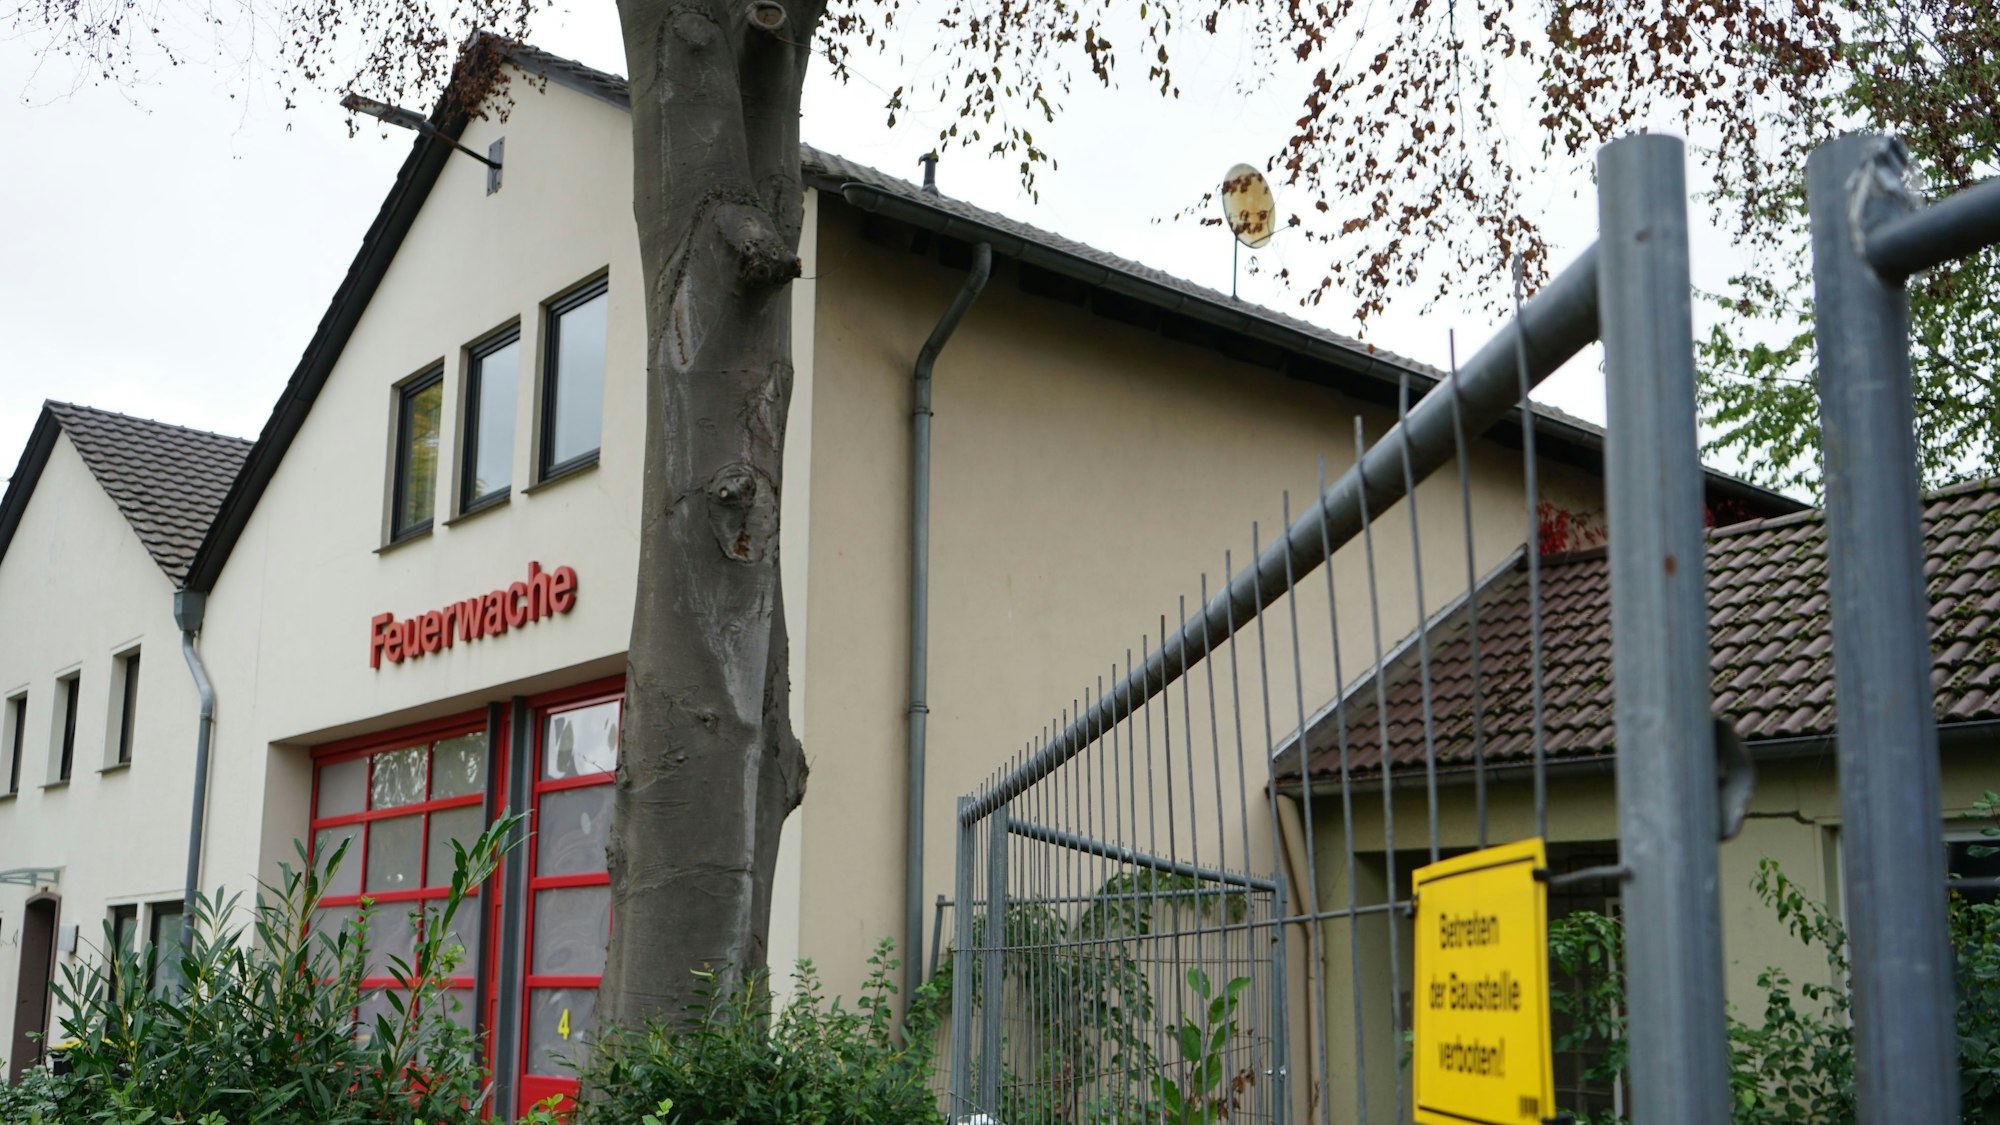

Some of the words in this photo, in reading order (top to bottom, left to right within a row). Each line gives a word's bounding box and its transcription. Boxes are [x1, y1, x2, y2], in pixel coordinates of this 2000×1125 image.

[370, 560, 577, 669] Feuerwache
[1440, 911, 1499, 949] Betreten
[1430, 973, 1446, 1010] der
[1450, 971, 1522, 1012] Baustelle
[557, 1008, 570, 1040] 4
[1439, 1036, 1505, 1078] verboten!
